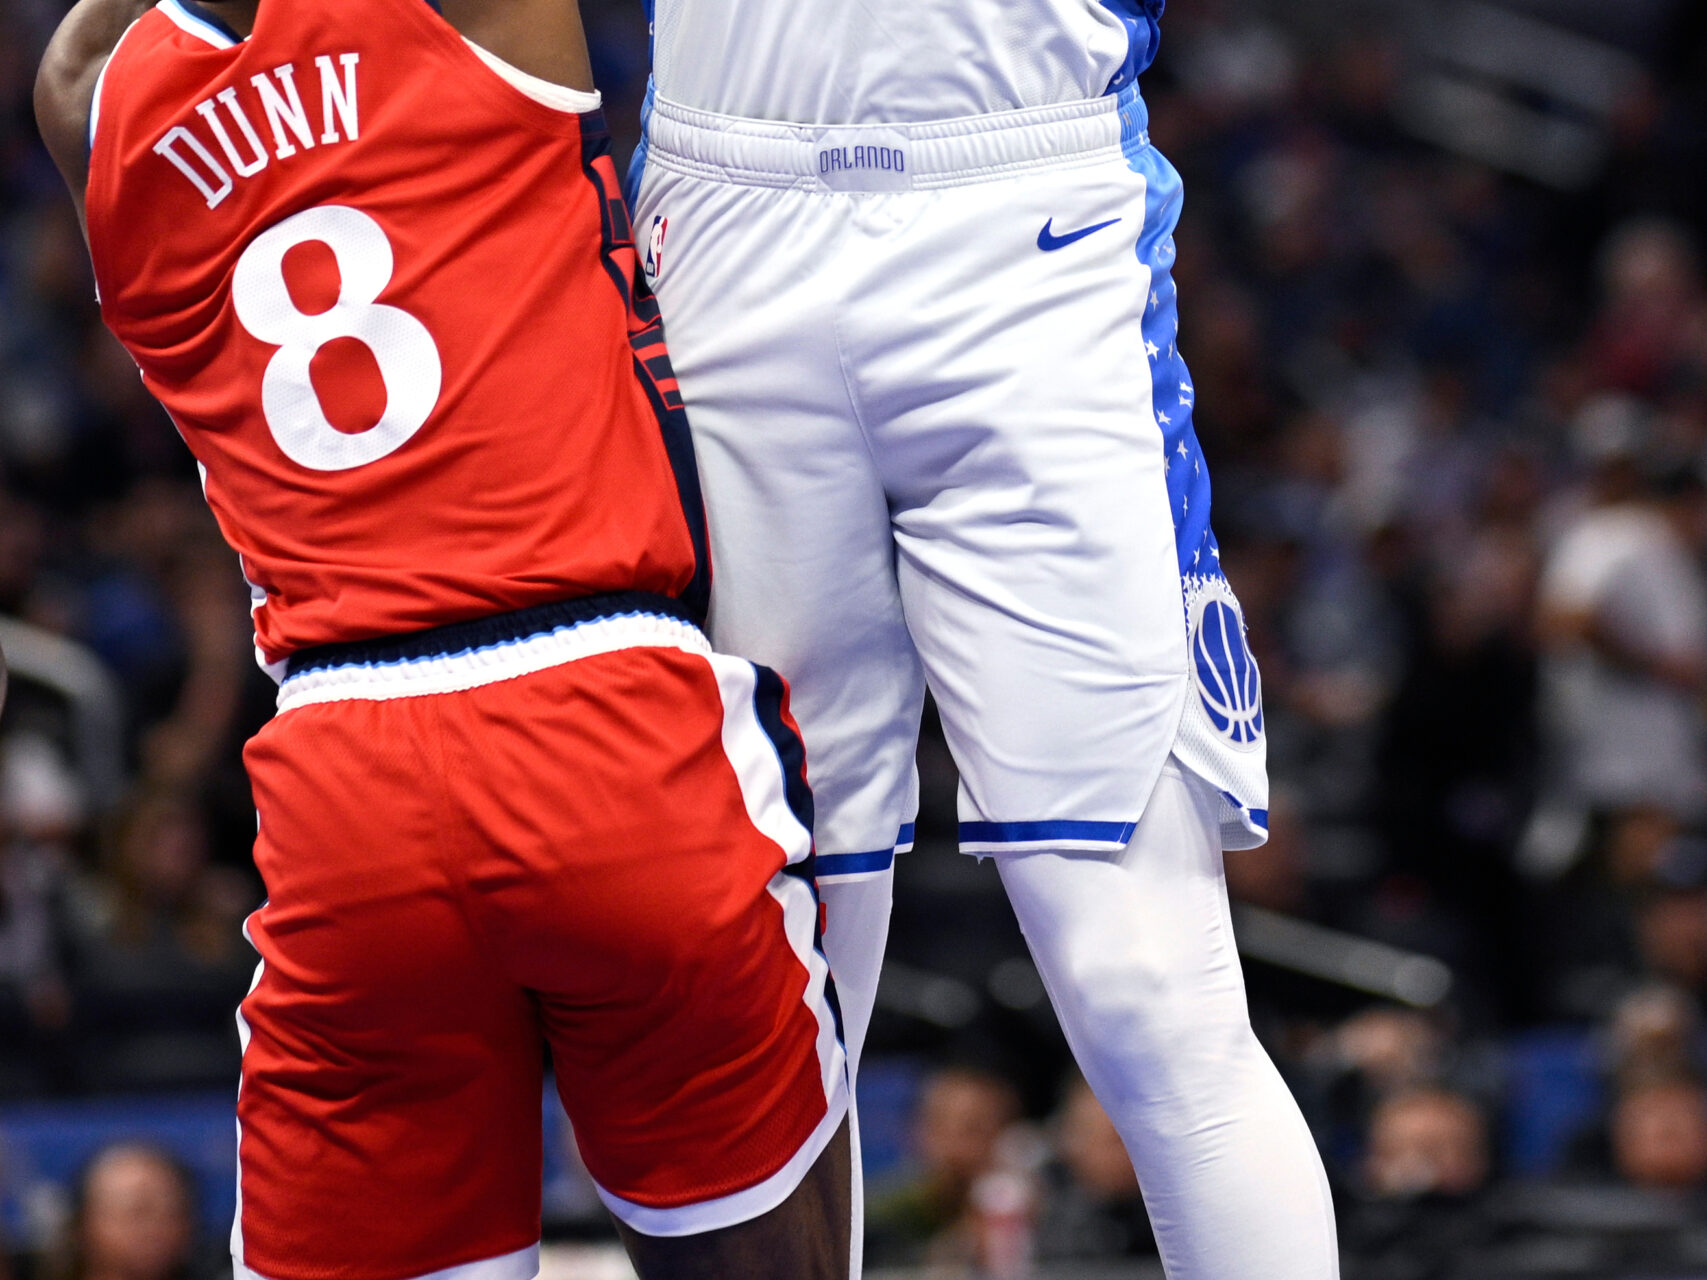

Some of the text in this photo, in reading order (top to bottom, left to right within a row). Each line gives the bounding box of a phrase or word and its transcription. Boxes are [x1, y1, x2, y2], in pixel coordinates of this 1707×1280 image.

[153, 53, 360, 210] DUNN
[820, 145, 904, 173] ORLANDO
[232, 205, 442, 471] 8
